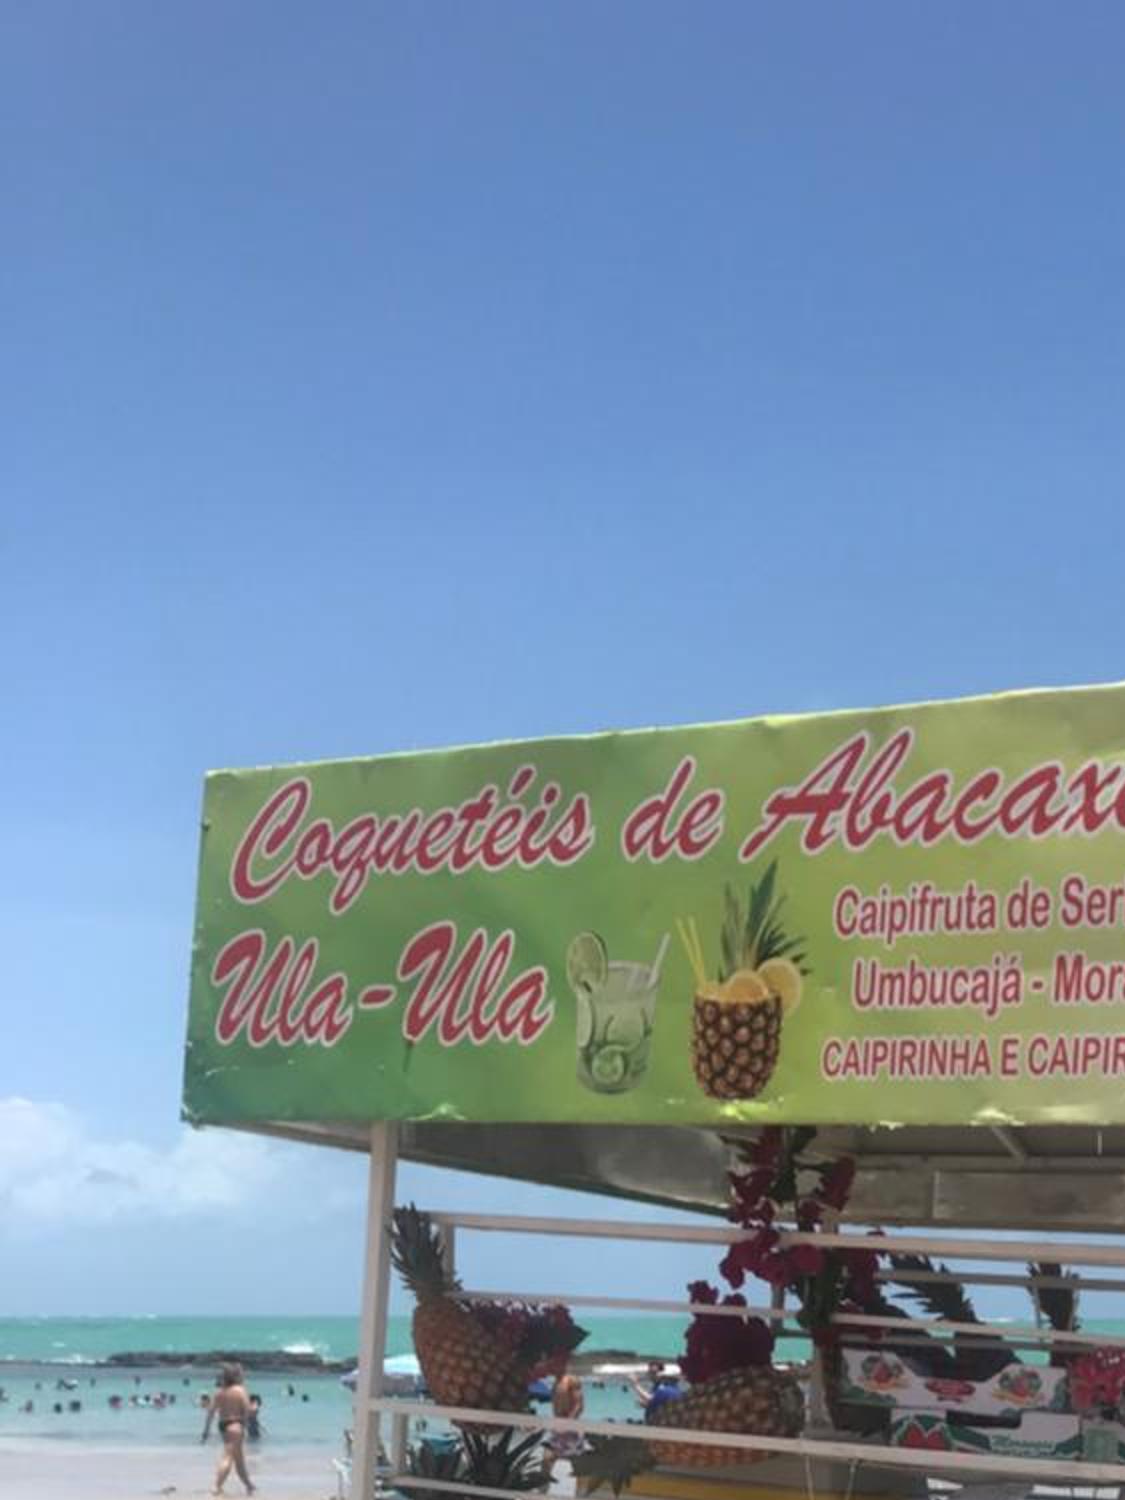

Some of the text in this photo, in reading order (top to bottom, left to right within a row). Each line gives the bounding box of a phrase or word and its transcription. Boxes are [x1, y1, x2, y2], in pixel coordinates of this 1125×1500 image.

[231, 766, 595, 916] Coquetéis
[622, 755, 723, 865] de
[834, 882, 997, 944] Caipifruta
[1007, 879, 1051, 930] de
[211, 920, 555, 1048] Ula-Ula
[854, 953, 1023, 1019] Umbucajá
[822, 1037, 992, 1079] CAIPIRINHA
[1000, 1036, 1020, 1077] E
